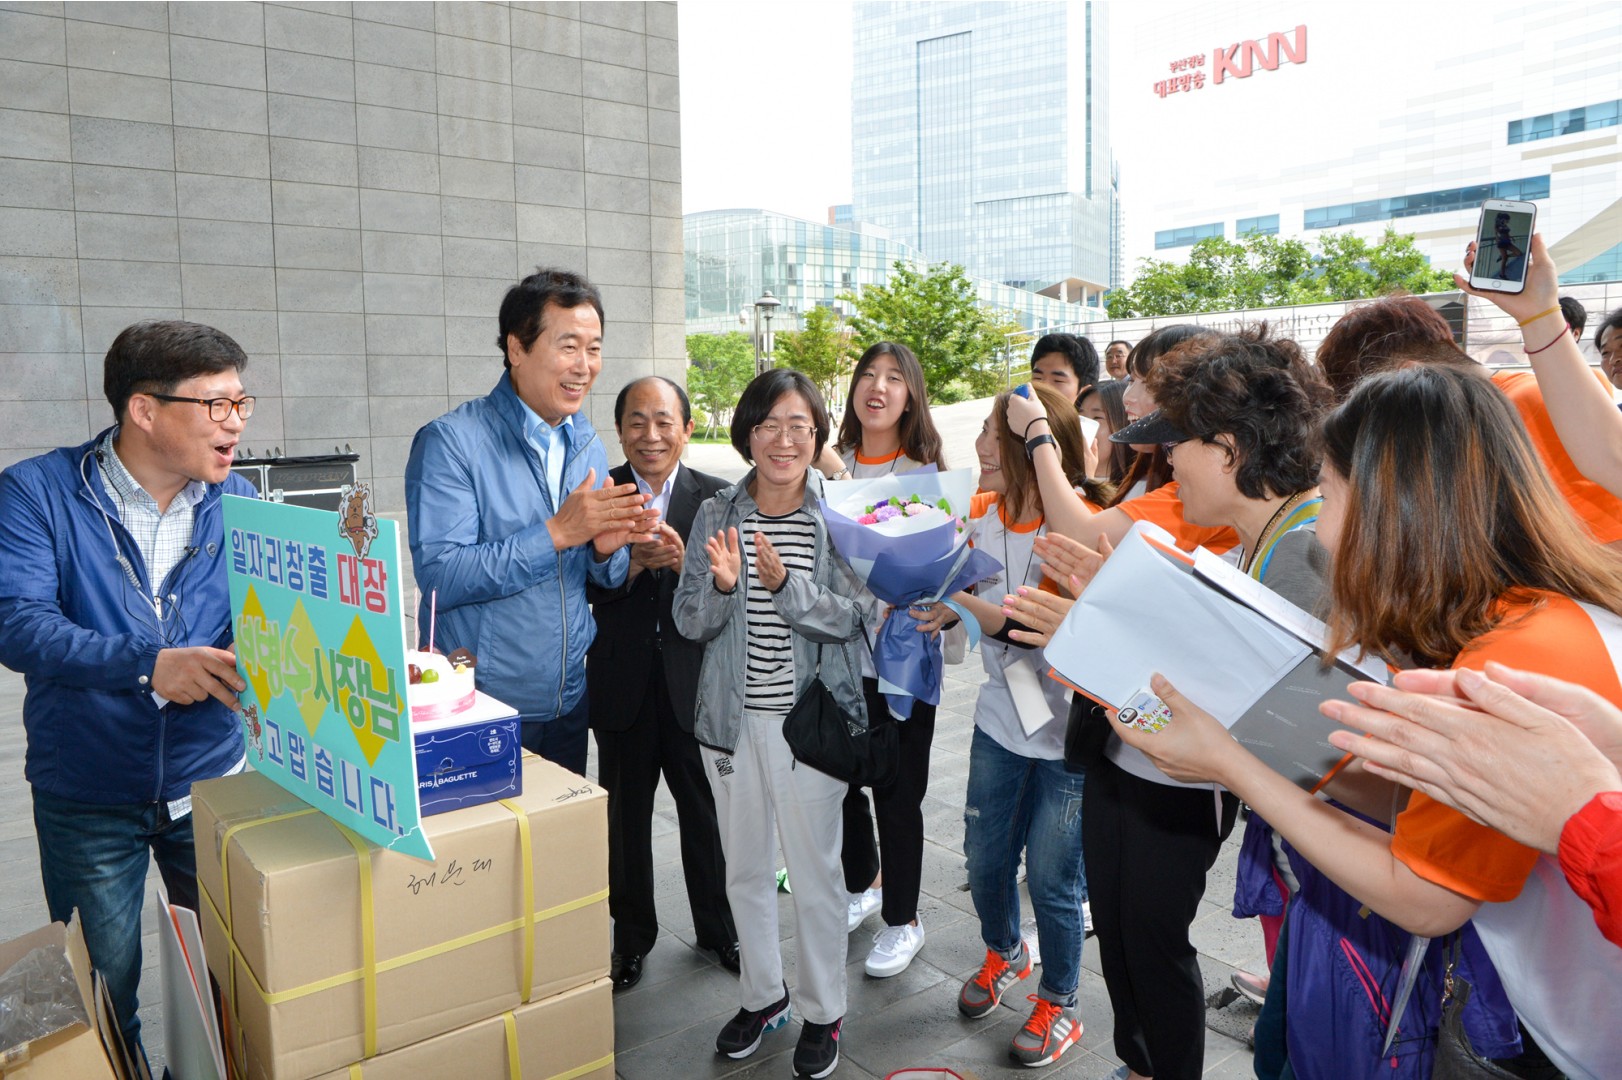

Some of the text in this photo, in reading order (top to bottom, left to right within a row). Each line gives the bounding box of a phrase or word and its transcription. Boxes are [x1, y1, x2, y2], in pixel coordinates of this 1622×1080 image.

[1153, 70, 1206, 98] 대표방송
[1213, 24, 1307, 84] KNN
[232, 529, 388, 614] 일자리창출 대장
[313, 647, 400, 742] 시장님
[265, 718, 404, 835] 고맙습니다.
[438, 771, 478, 785] BAGUETTE
